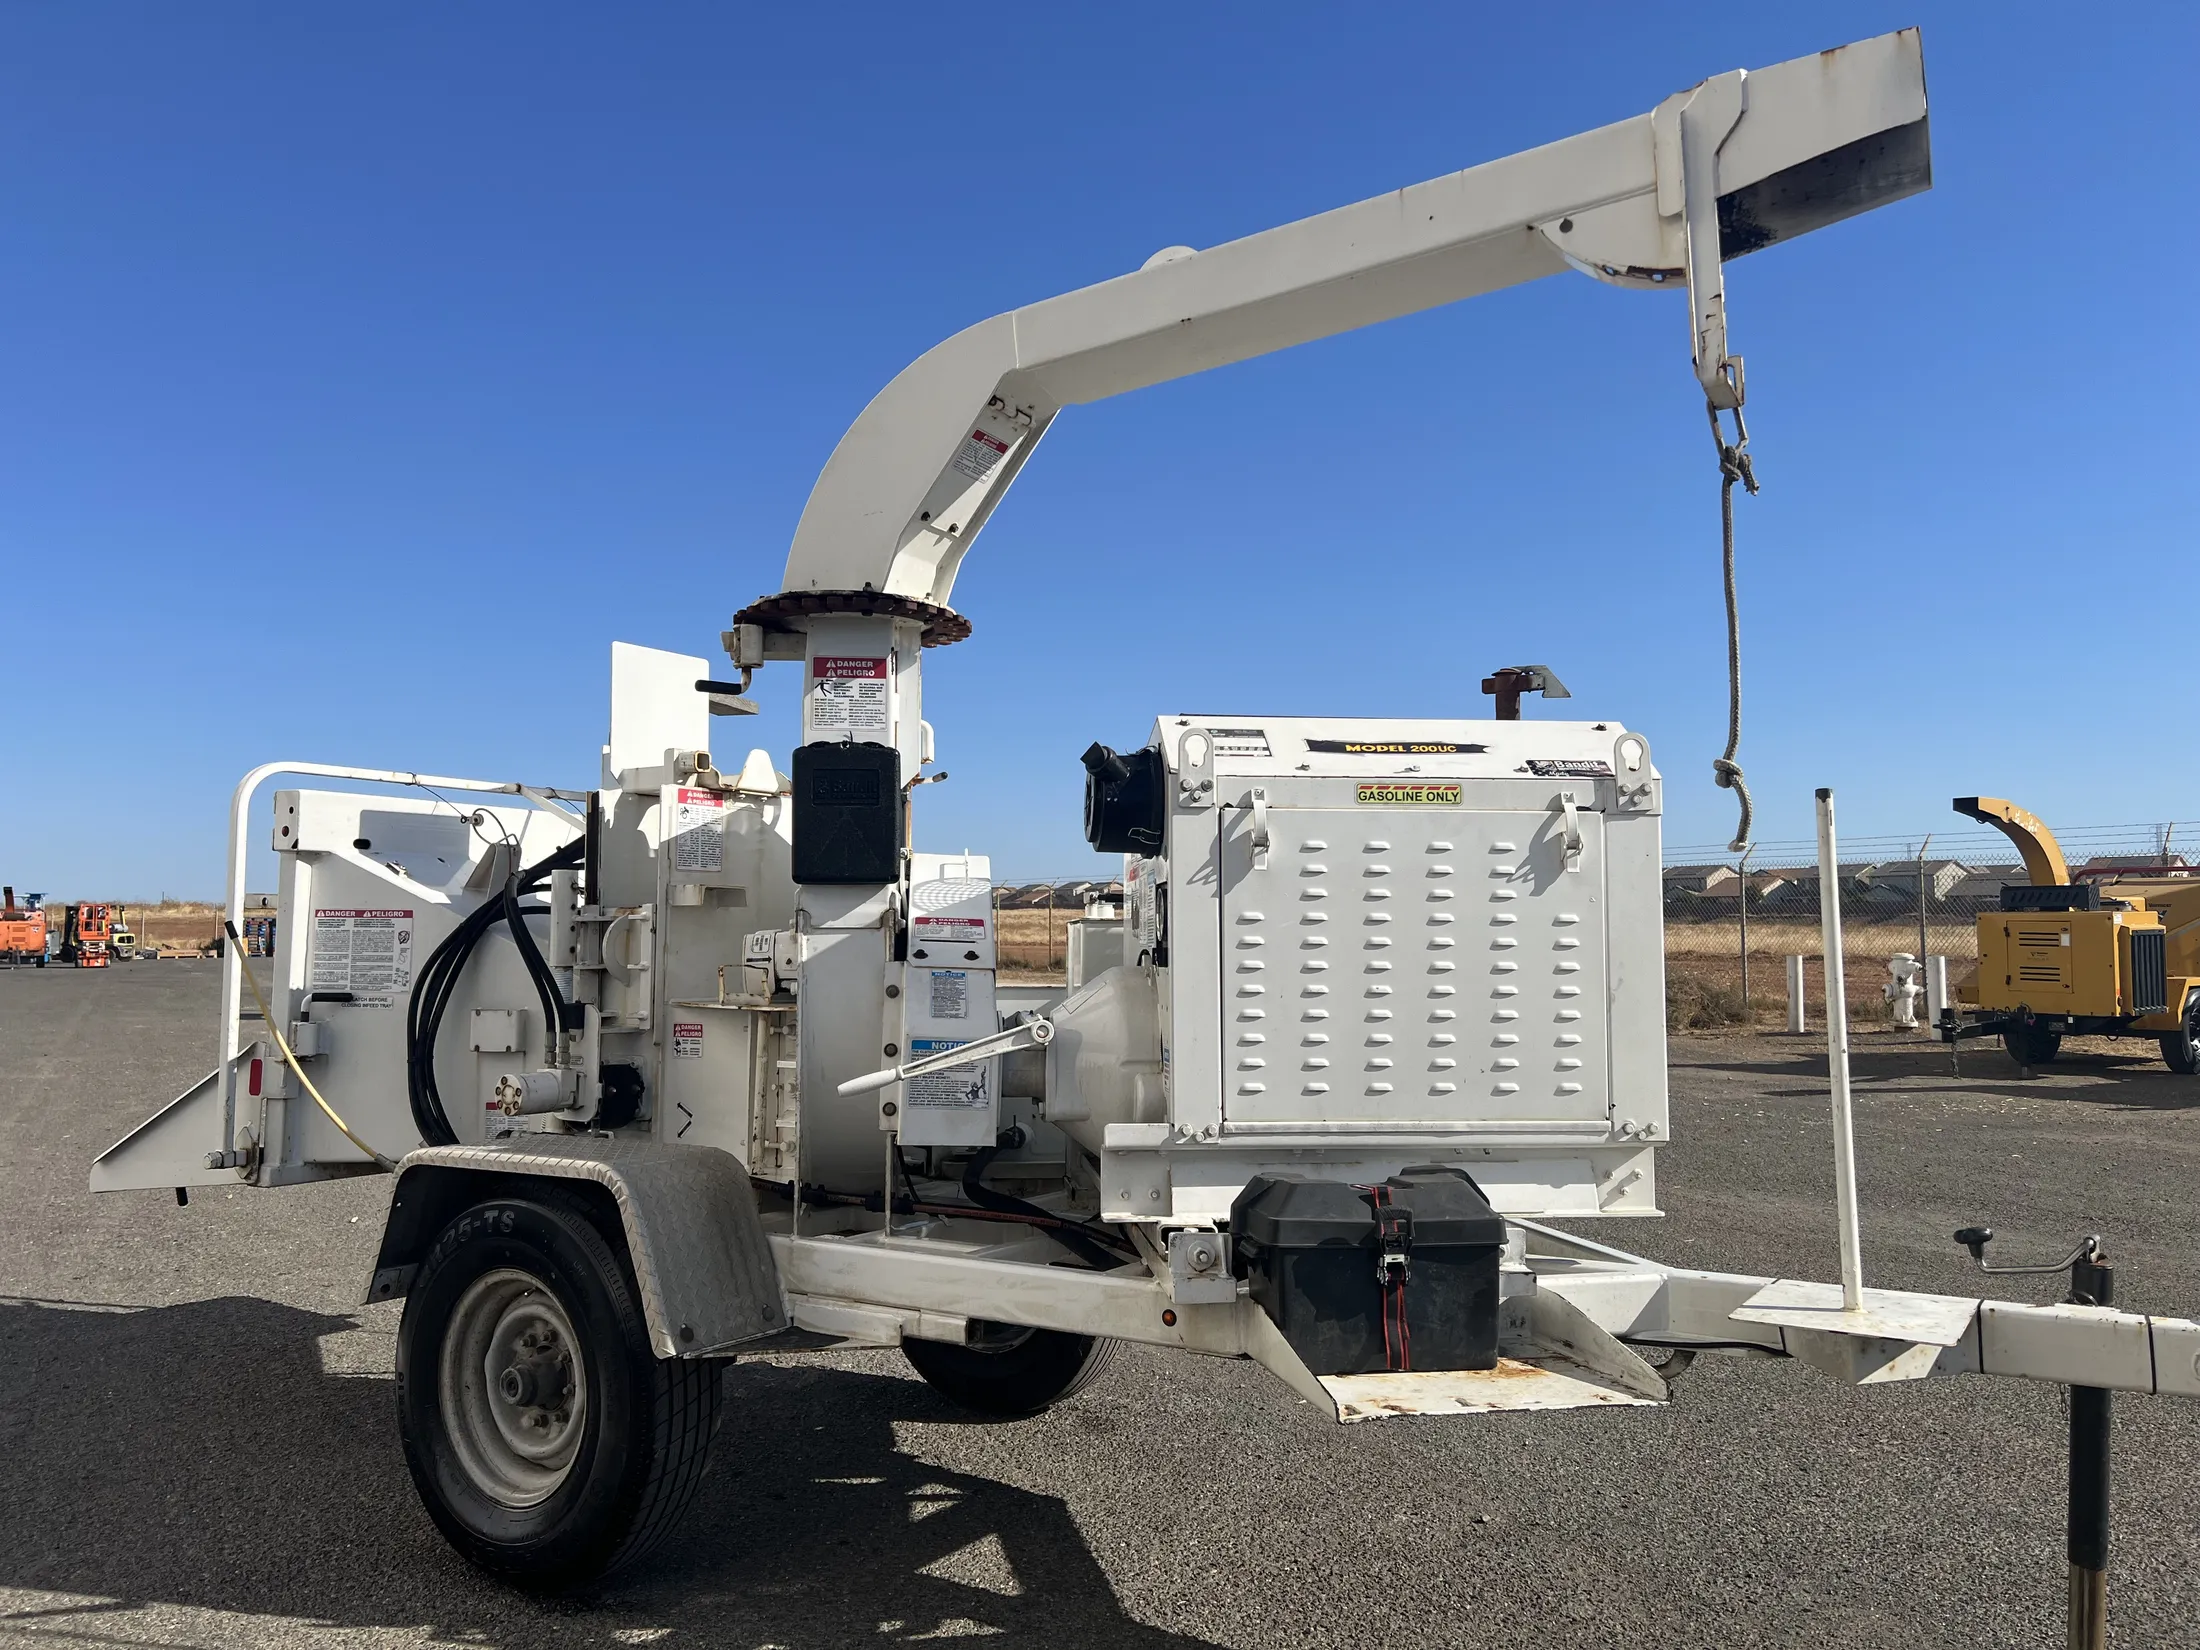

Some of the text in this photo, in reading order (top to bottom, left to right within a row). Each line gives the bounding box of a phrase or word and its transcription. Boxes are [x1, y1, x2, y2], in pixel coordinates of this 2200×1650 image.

[837, 660, 873, 668] DANGER
[837, 669, 875, 677] PELIGRO
[1345, 744, 1457, 753] MODEL 200UC
[1553, 760, 1600, 769] Bandit
[1358, 791, 1460, 803] GASOLINE ONLY
[693, 799, 715, 807] PELIGRO
[931, 1041, 967, 1050] NOTIC
